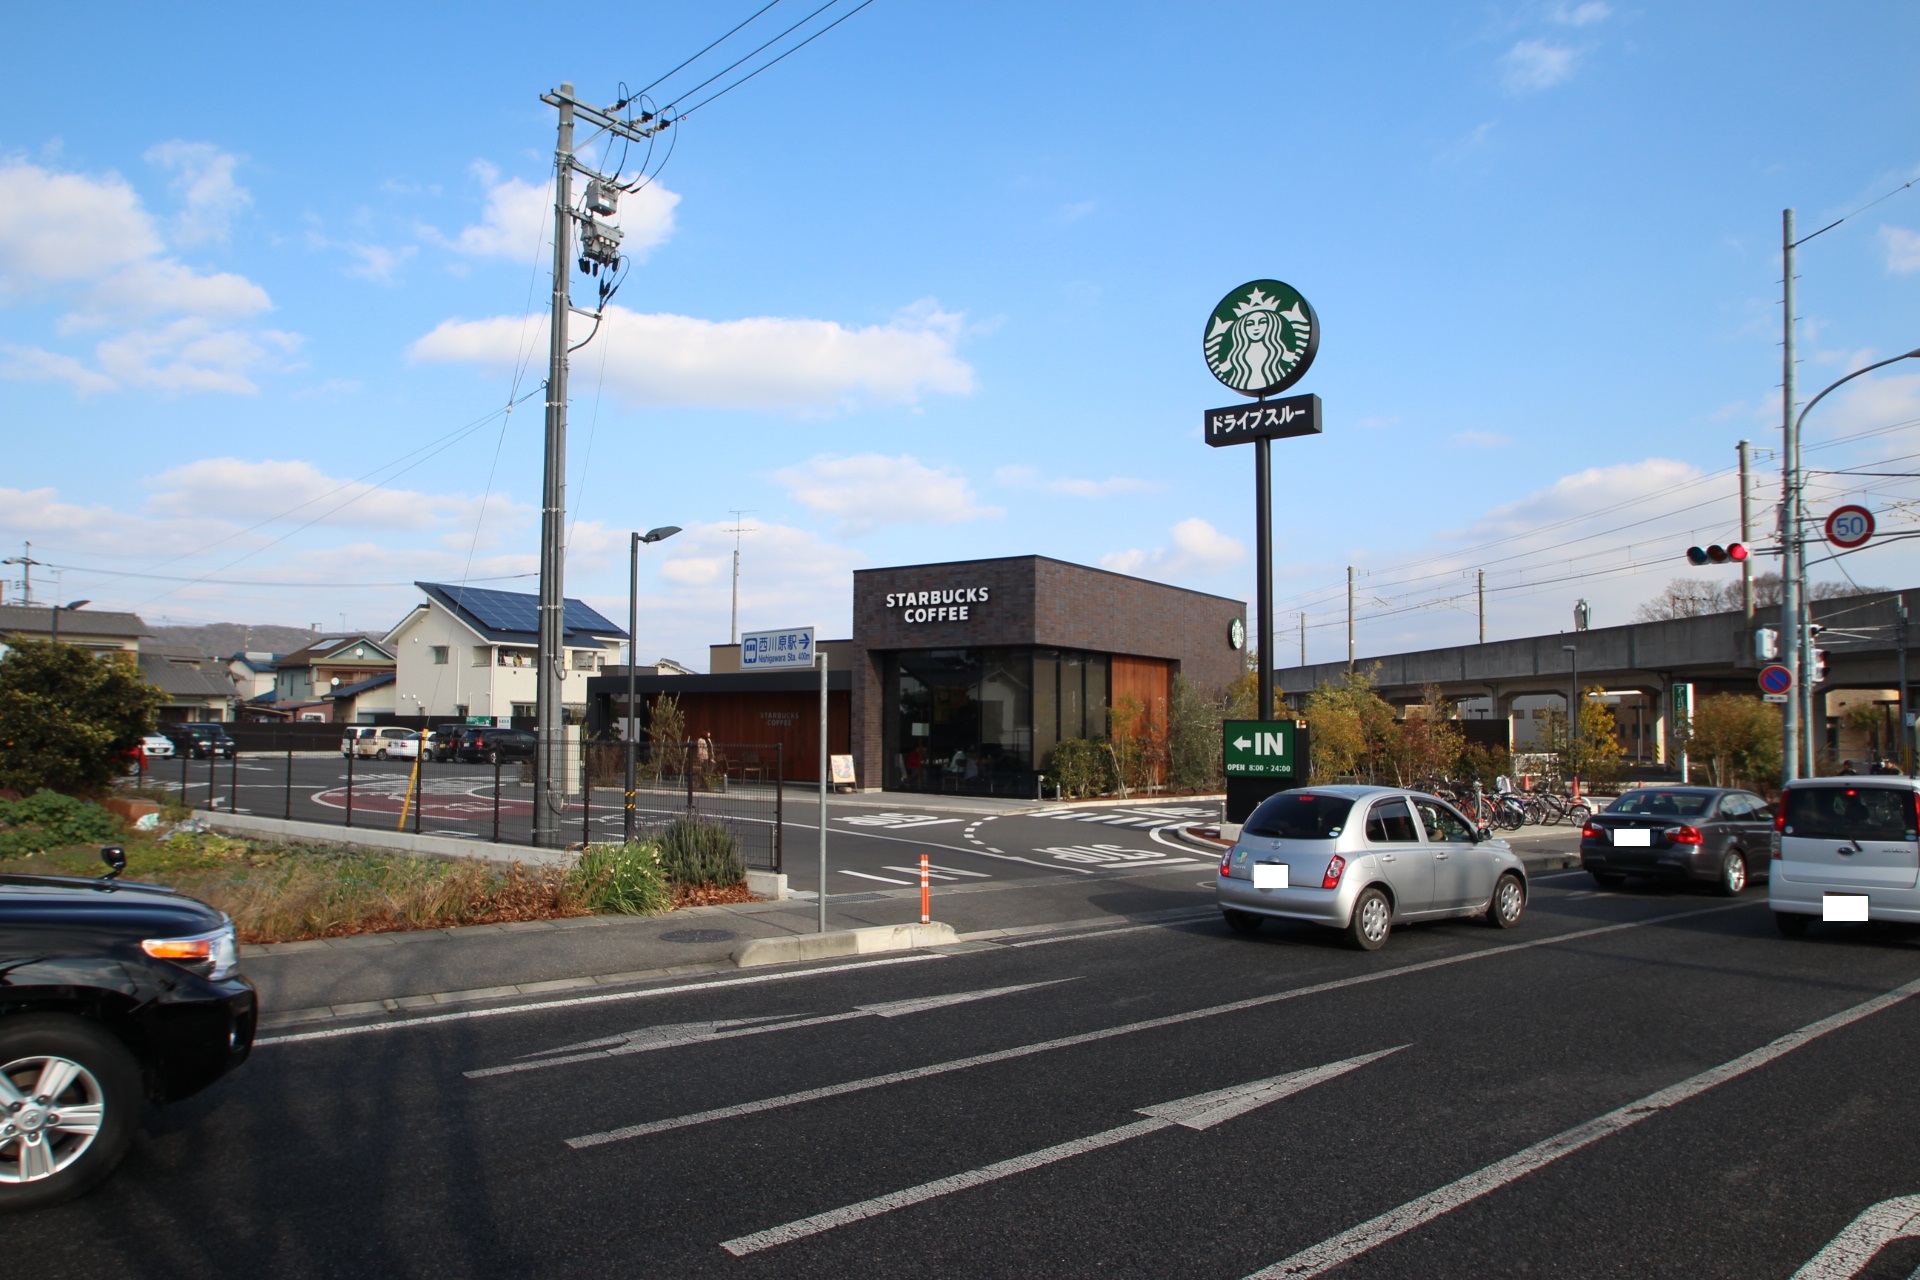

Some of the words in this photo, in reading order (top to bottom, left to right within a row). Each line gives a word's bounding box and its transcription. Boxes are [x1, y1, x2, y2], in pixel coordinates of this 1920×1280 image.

[1212, 405, 1306, 435] ドライブスルー
[1836, 516, 1864, 537] 50
[886, 587, 989, 608] STARBUCKS
[904, 606, 969, 623] COFFEE
[759, 634, 797, 652] 西川原駅
[758, 655, 786, 664] Nishigawara
[760, 711, 800, 719] STARBUCKS
[767, 719, 792, 727] COFFEE
[1254, 732, 1284, 756] IN
[1227, 763, 1246, 771] OPEN
[1031, 844, 1167, 864] STOP
